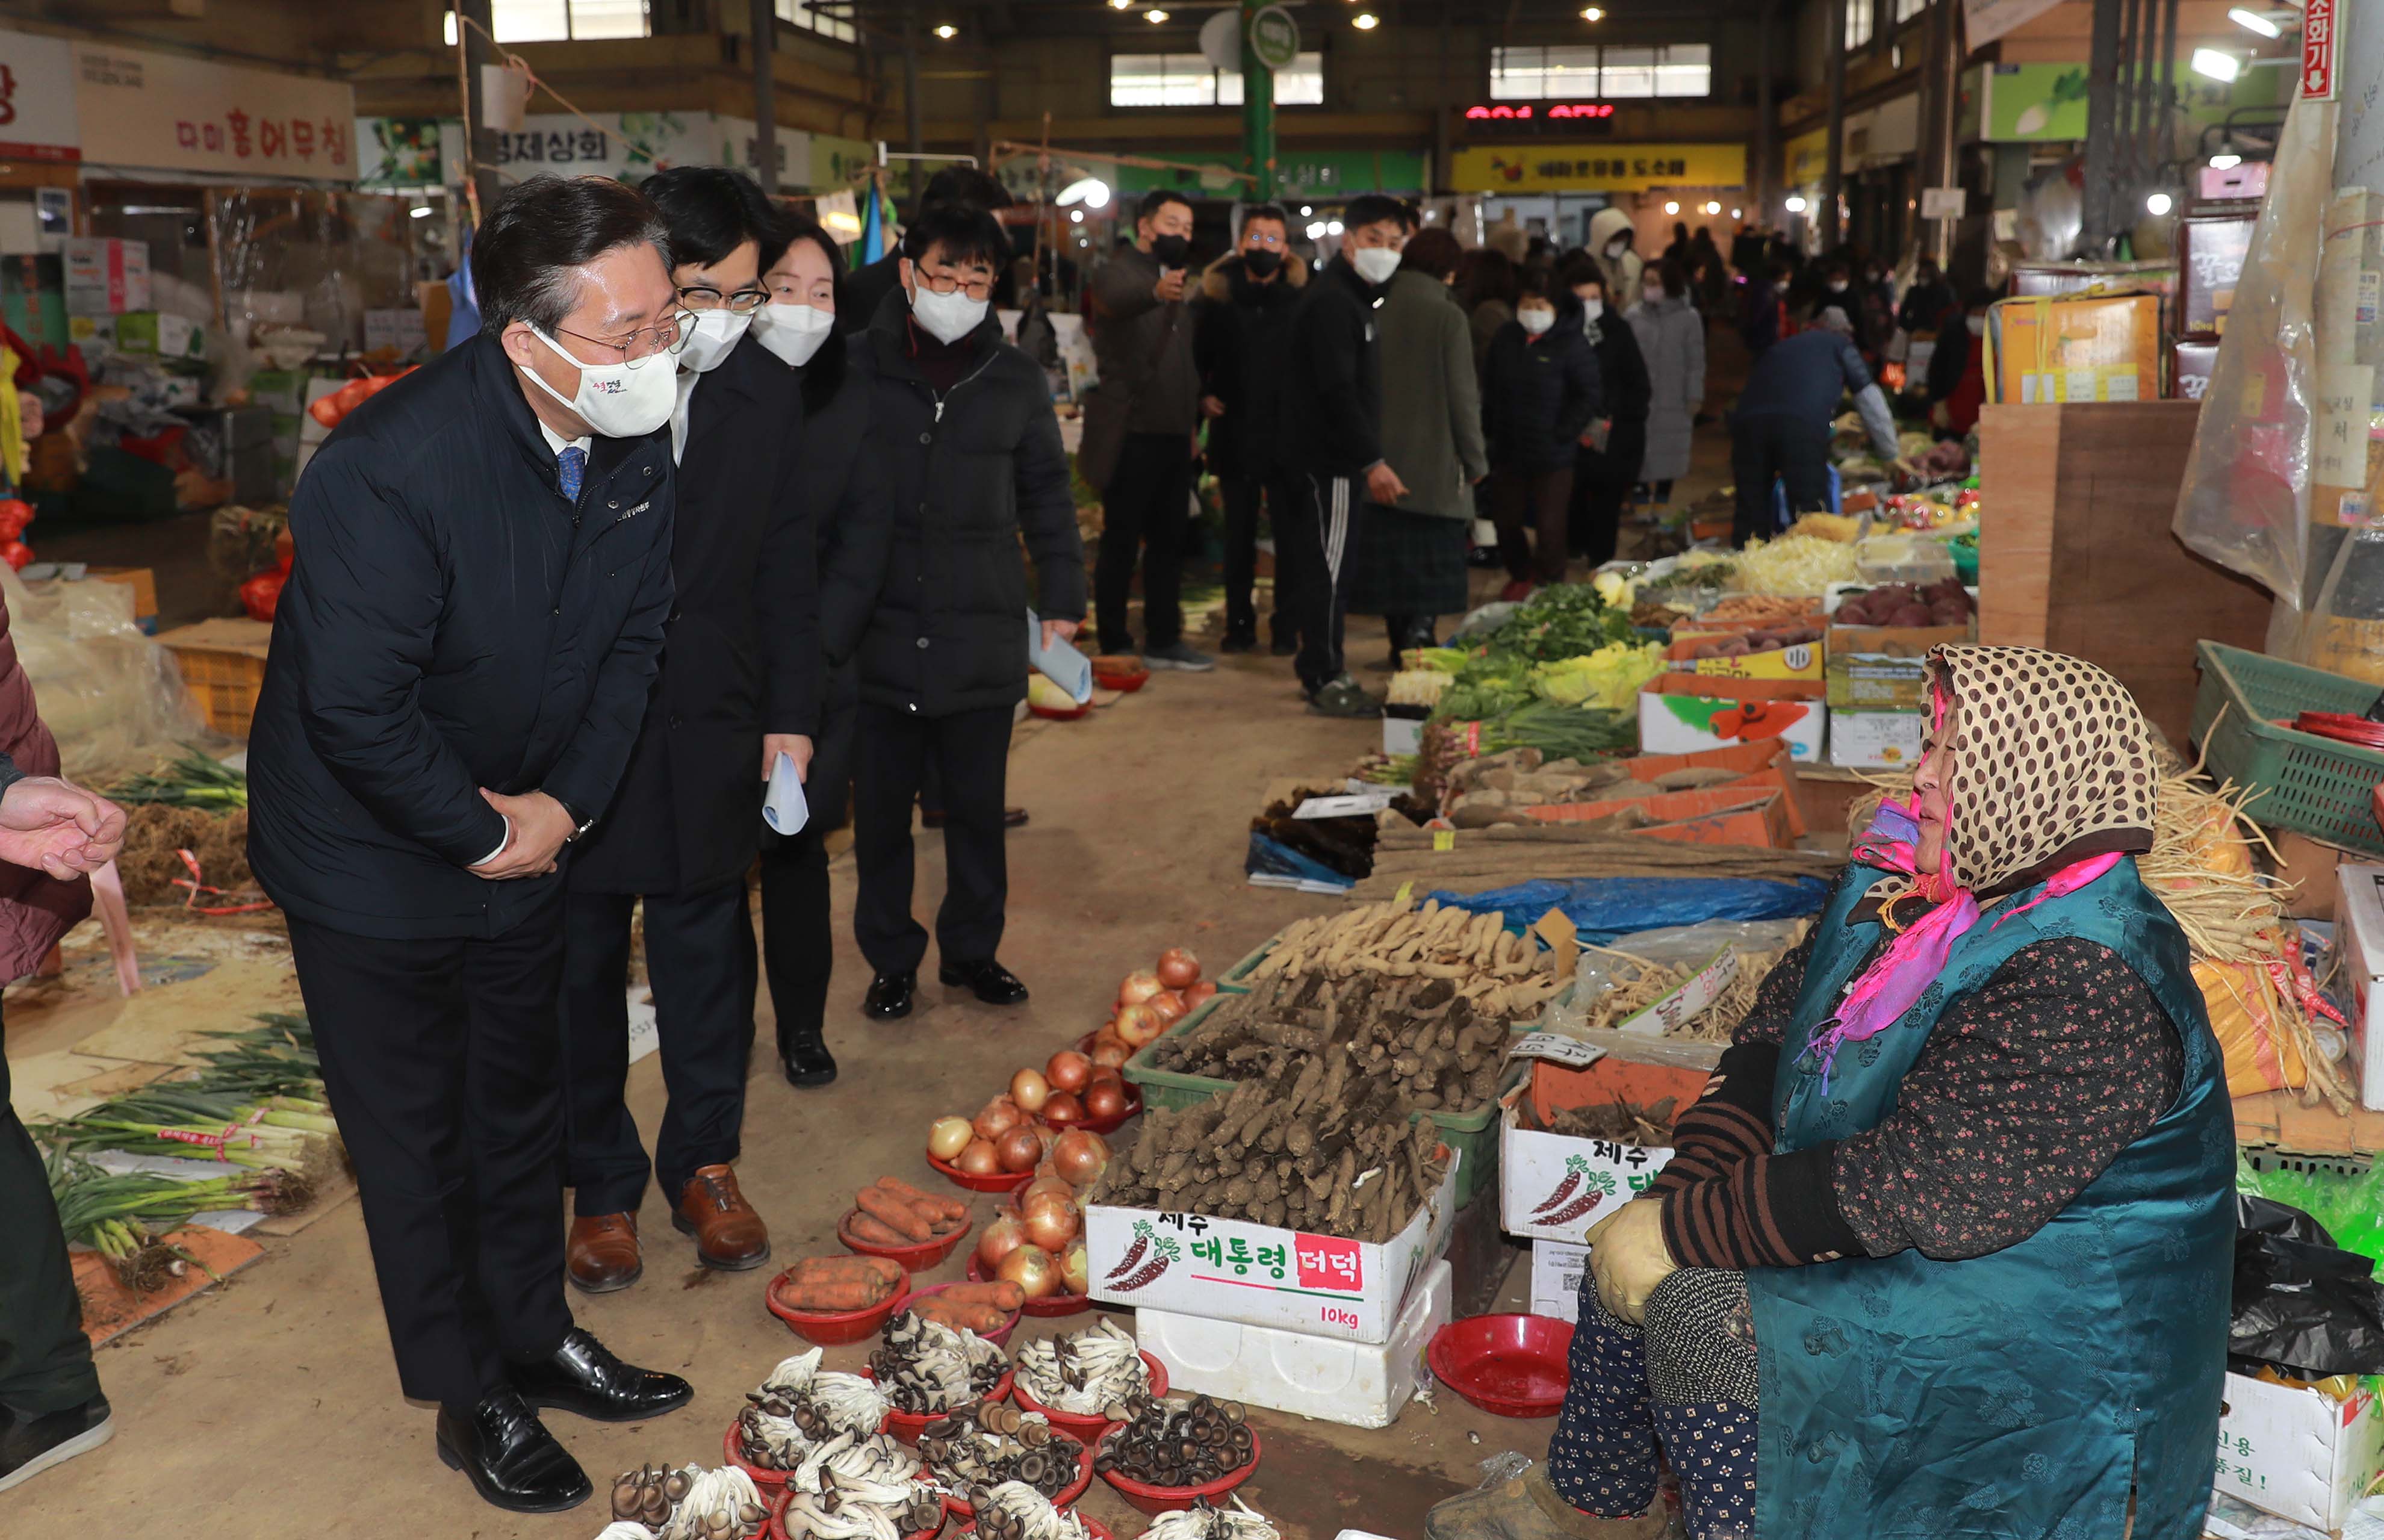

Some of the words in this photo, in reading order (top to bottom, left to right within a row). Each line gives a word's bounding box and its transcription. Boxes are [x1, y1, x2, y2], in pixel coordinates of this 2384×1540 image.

[1190, 1236, 1286, 1279] 대통령
[1299, 1250, 1358, 1283] 더덕
[1321, 1306, 1359, 1330] 10kg
